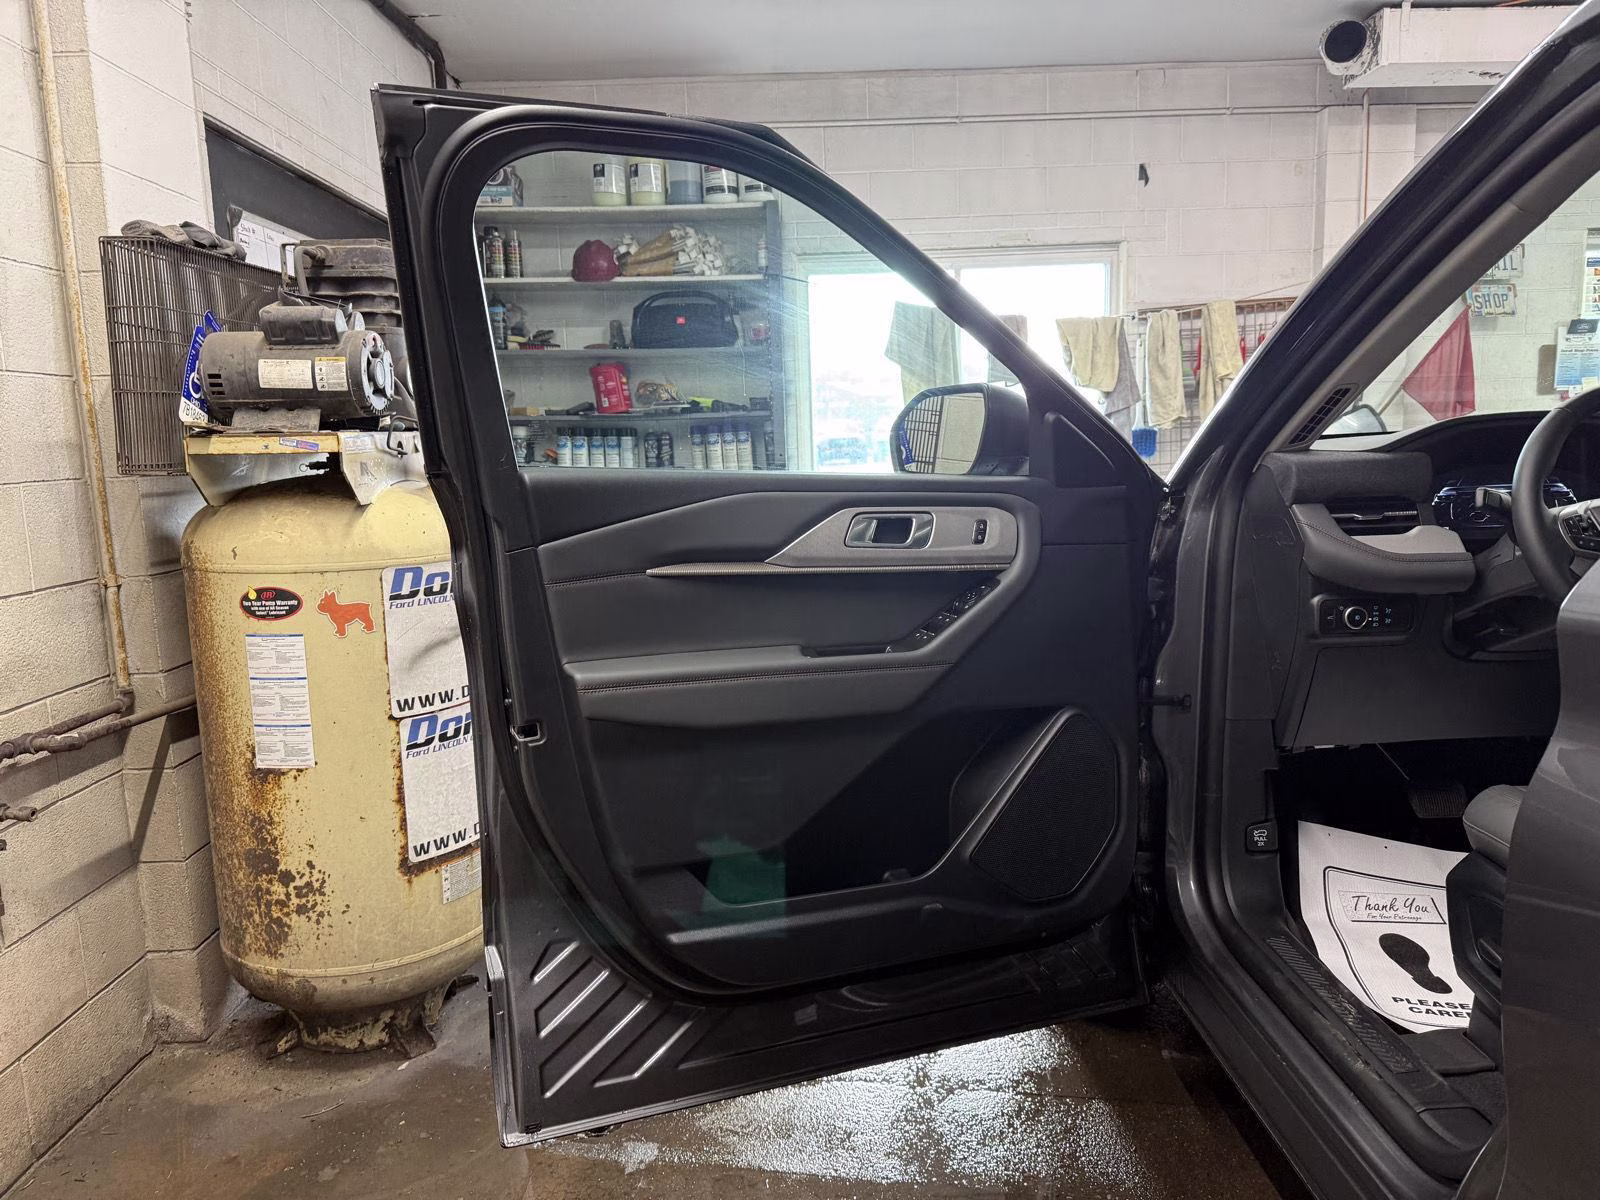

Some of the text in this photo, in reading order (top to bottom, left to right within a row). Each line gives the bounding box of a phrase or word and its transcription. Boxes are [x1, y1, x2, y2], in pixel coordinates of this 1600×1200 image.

[1474, 293, 1508, 310] SHOP
[389, 601, 415, 610] Ford
[406, 736, 468, 759] Ford LINCOLN
[1352, 896, 1429, 913] Thank You
[1392, 996, 1472, 1011] PLEASE
